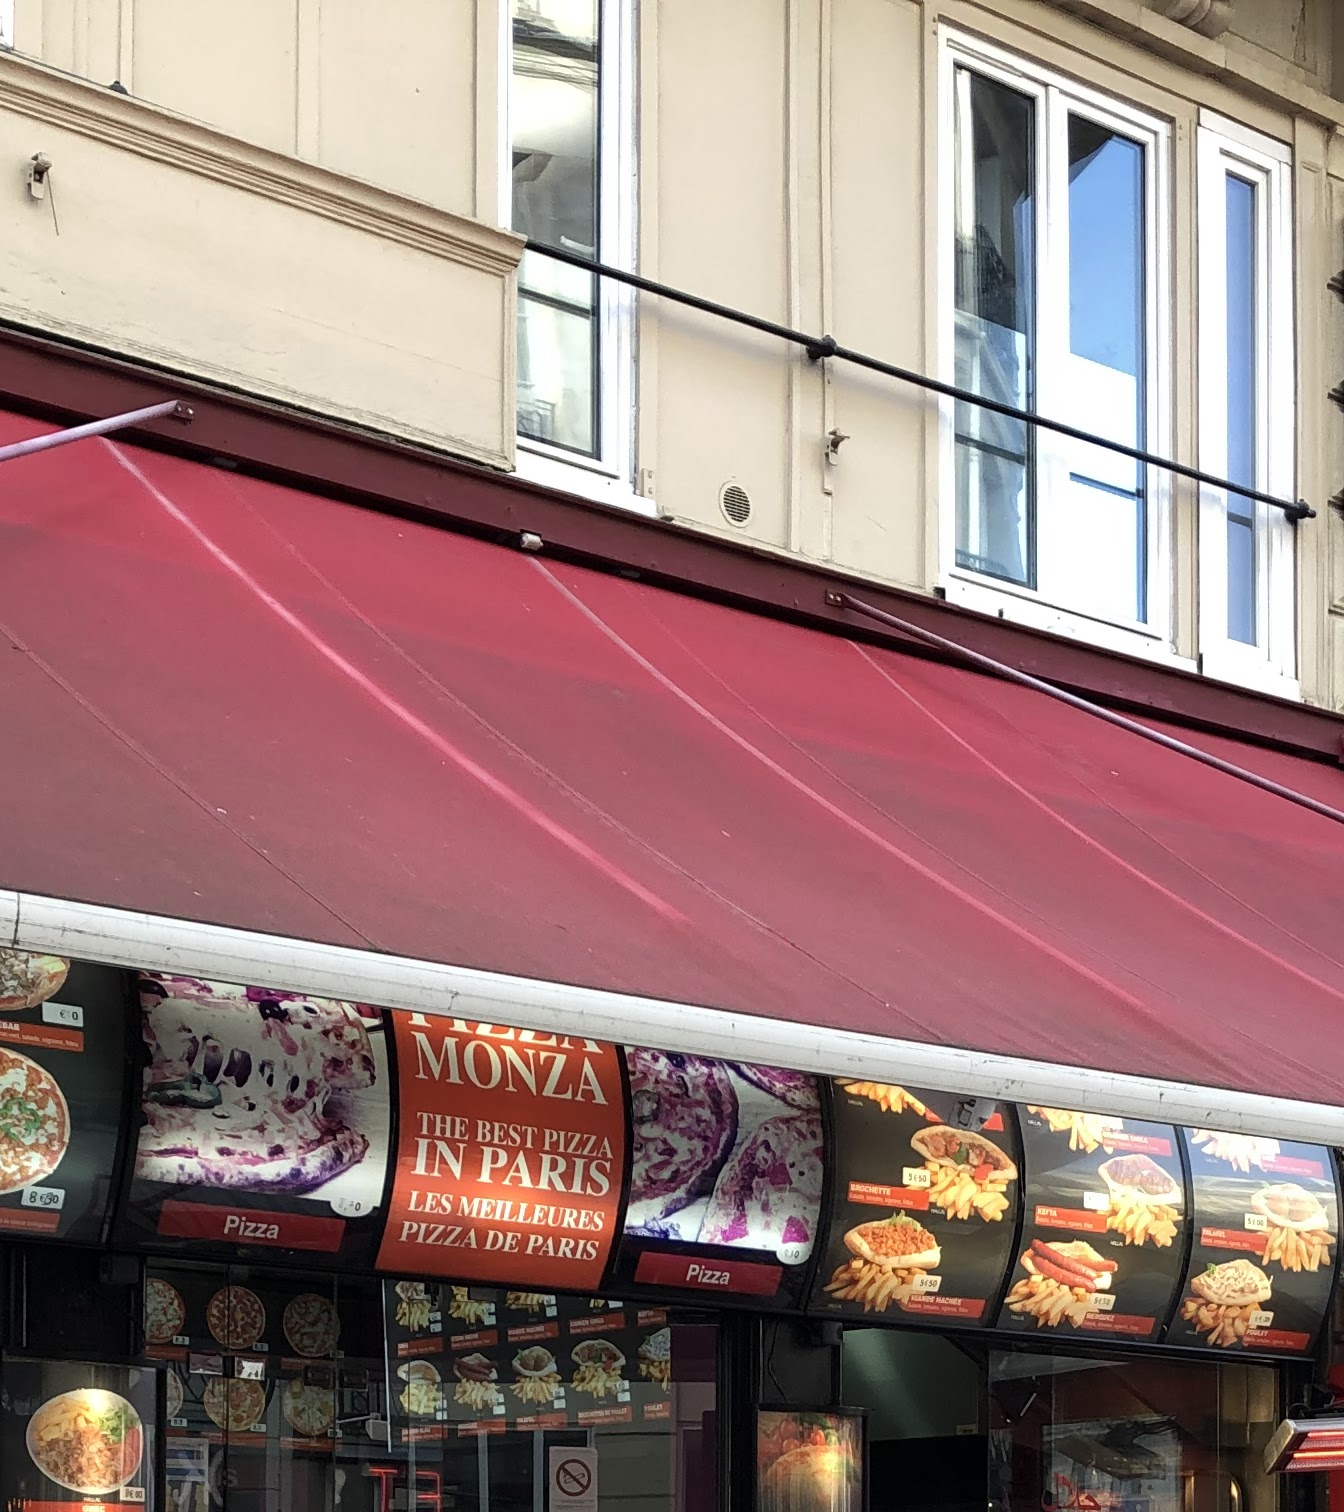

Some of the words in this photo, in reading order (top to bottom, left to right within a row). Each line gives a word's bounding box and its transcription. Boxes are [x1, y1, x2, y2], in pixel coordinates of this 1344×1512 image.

[411, 1030, 609, 1106] MONZA
[416, 1111, 470, 1141] THE
[475, 1119, 538, 1150] BEST
[543, 1128, 614, 1160] PIZZA
[410, 1137, 468, 1181] IN
[476, 1144, 611, 1197] PARIS
[223, 1215, 279, 1241] Pizza
[407, 1190, 454, 1216] LES
[457, 1196, 605, 1232] MEILLEURES
[398, 1220, 478, 1249] PIZZA
[481, 1229, 522, 1253] DE
[524, 1233, 600, 1261] PARIS
[685, 1262, 732, 1288] Pizza
